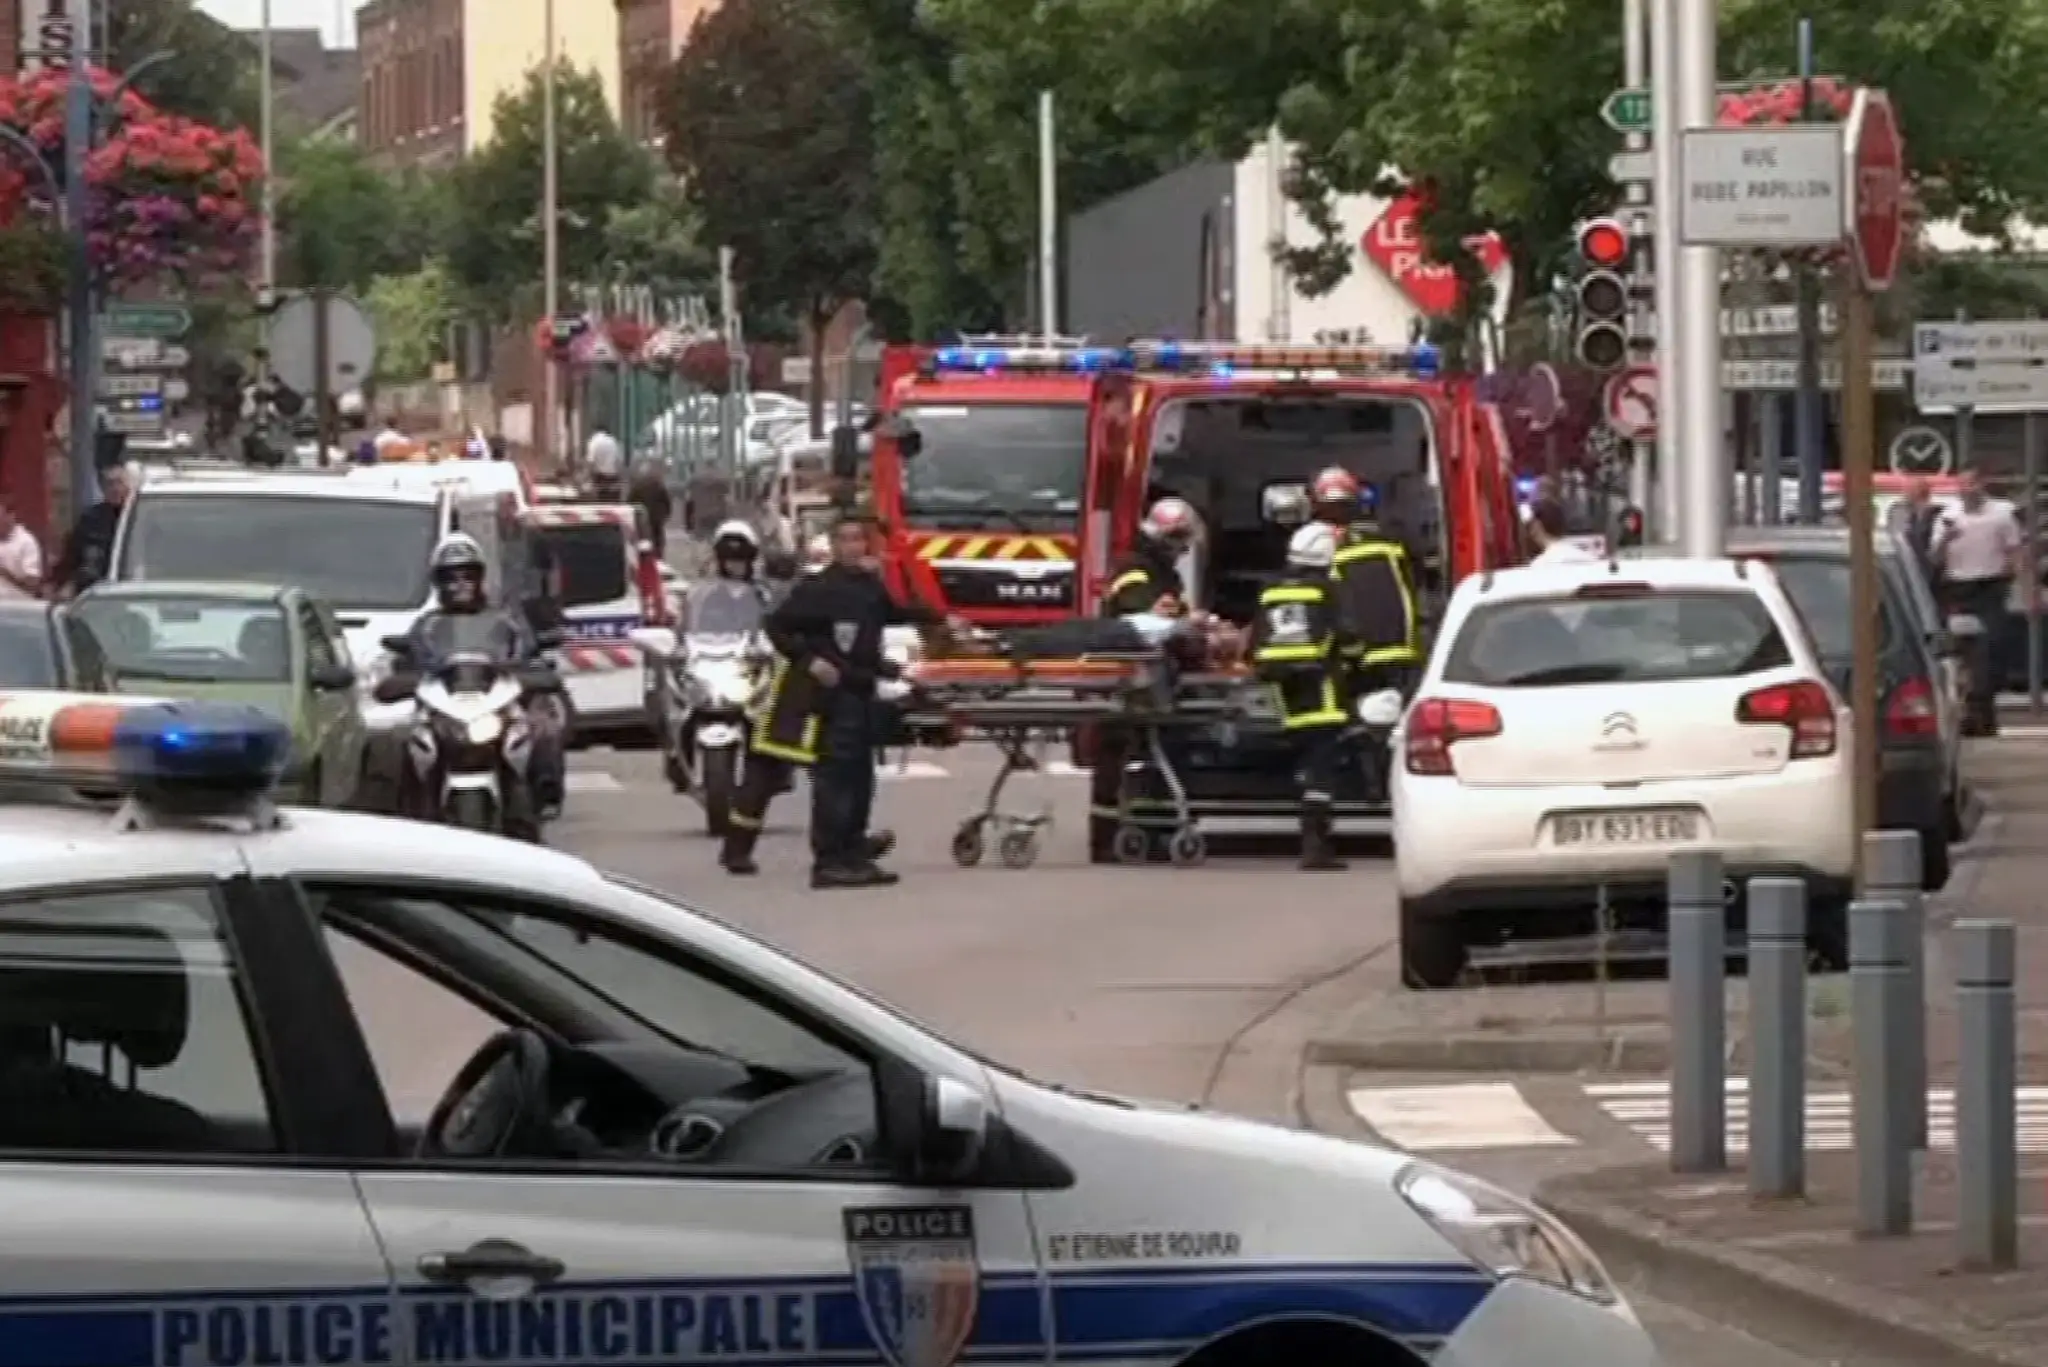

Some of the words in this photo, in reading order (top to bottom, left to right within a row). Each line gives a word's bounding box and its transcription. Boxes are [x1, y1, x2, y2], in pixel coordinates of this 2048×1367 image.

[853, 1212, 965, 1236] POLICE
[162, 1303, 392, 1367] POLICE
[412, 1294, 807, 1364] MUNICIPALE
